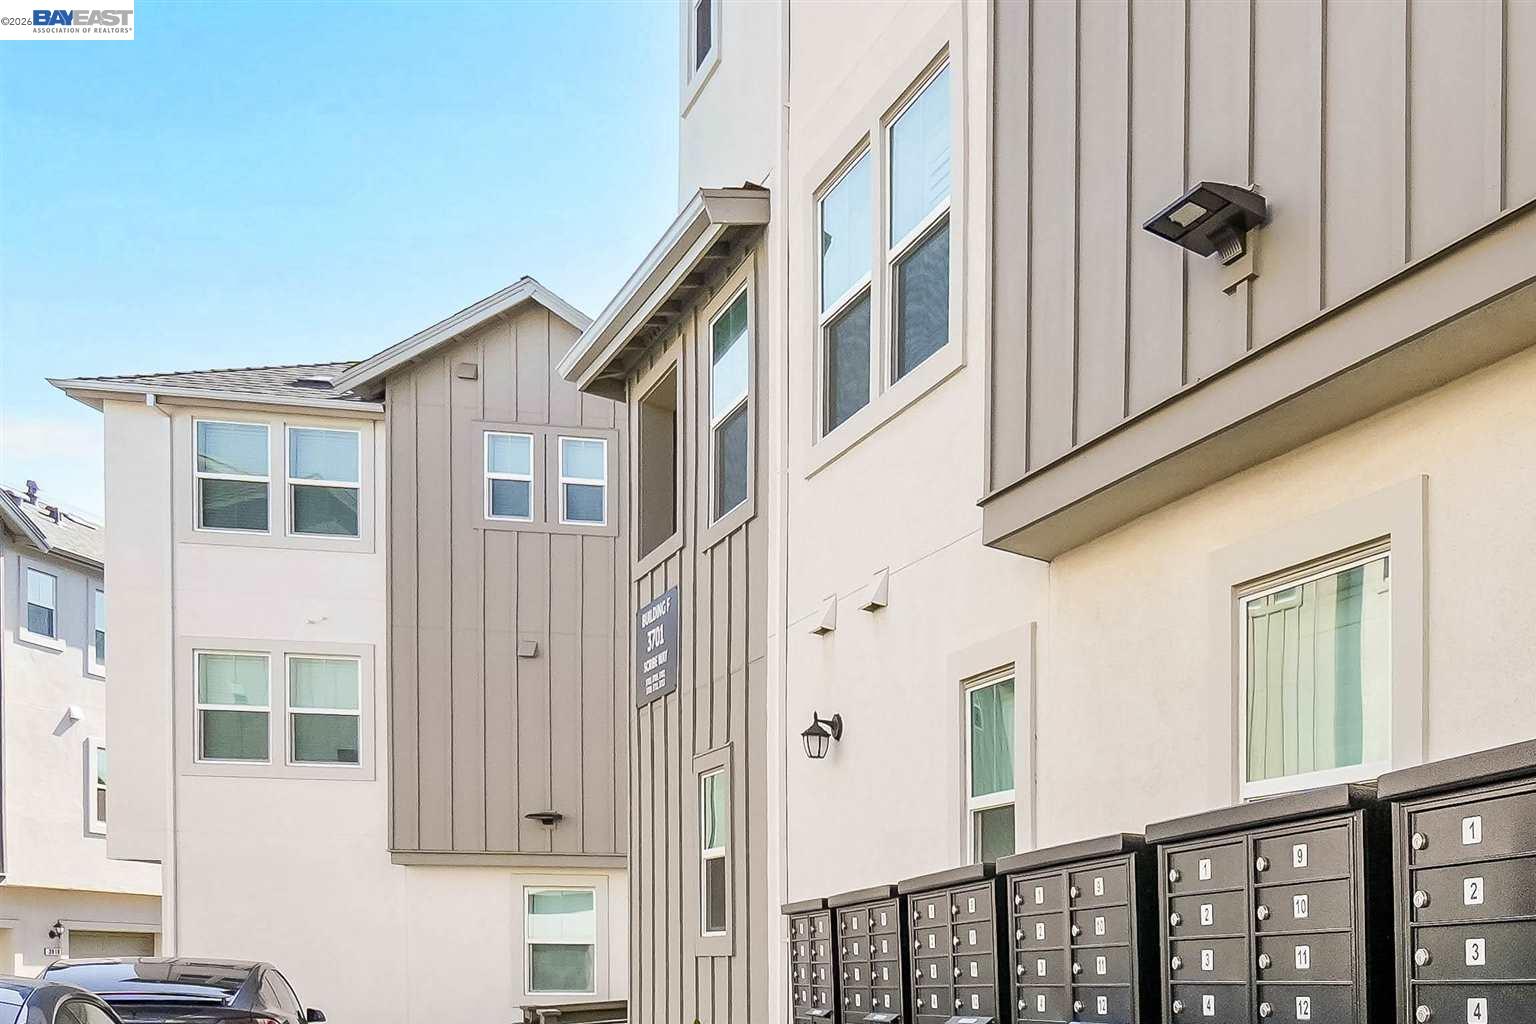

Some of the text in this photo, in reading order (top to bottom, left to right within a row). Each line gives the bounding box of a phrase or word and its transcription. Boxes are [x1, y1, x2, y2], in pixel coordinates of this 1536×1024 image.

[641, 600, 666, 629] BUILDING
[1470, 882, 1478, 900] 2
[1471, 943, 1480, 961] 3
[1473, 1002, 1482, 1021] 4
